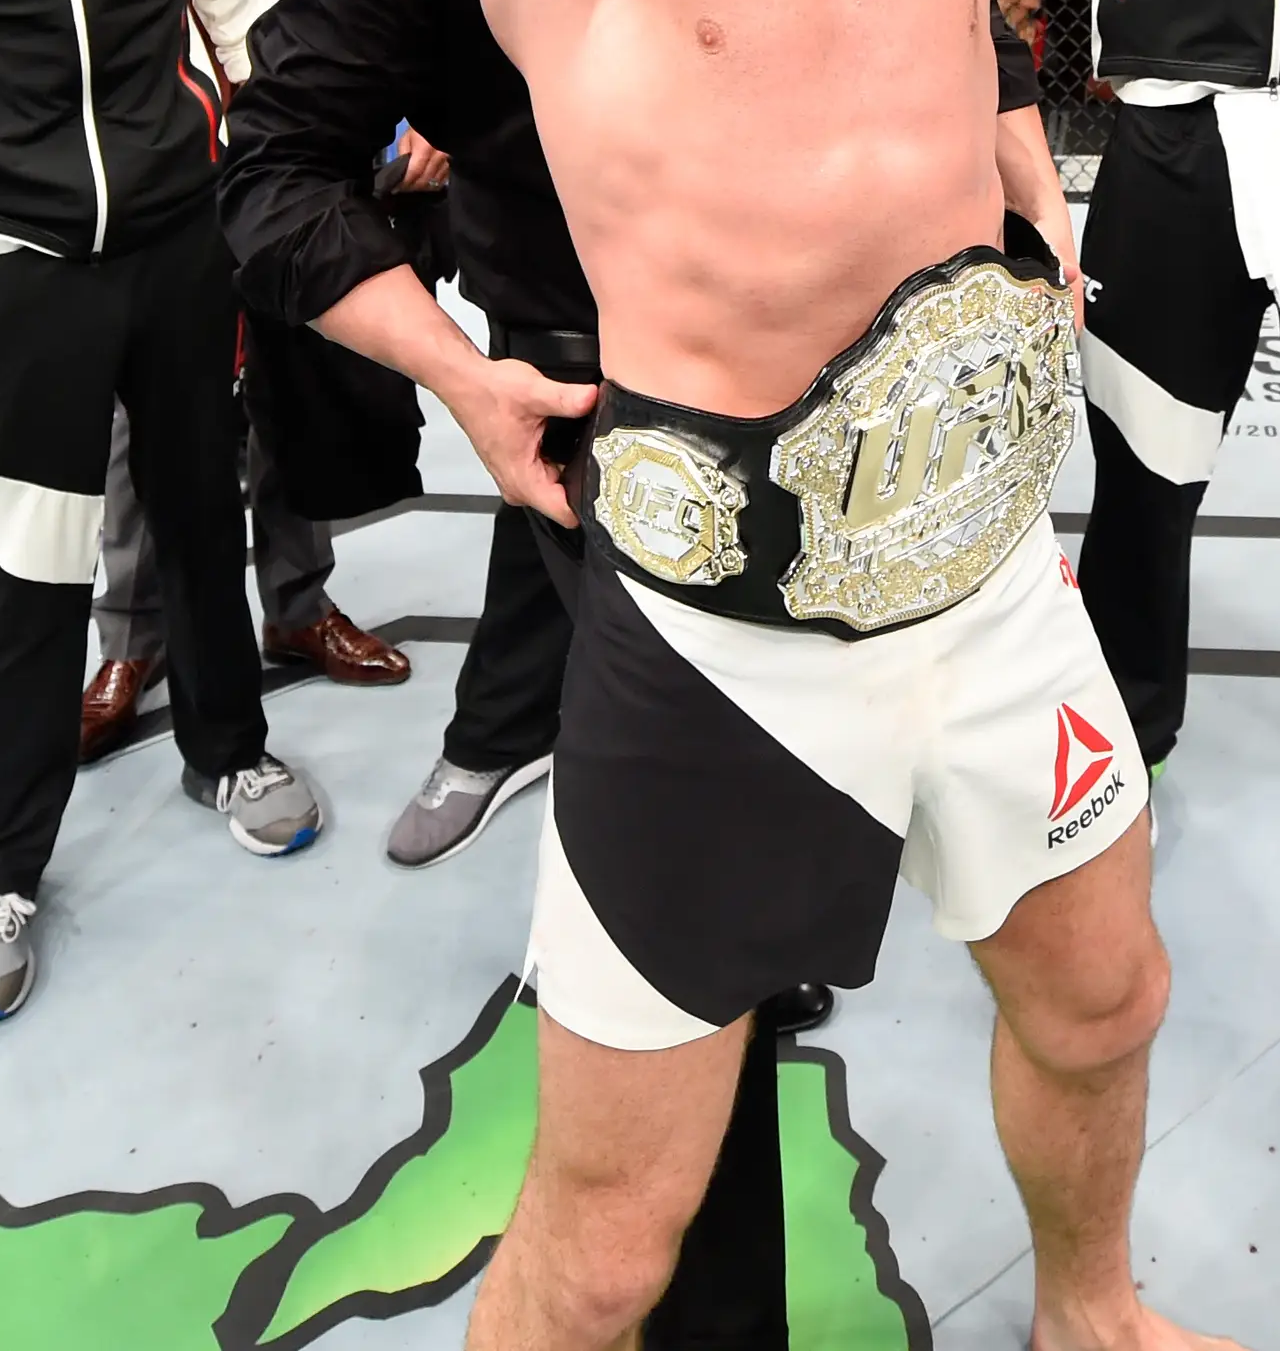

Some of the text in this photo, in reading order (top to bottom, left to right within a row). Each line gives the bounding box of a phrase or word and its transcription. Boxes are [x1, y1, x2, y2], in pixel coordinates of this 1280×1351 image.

[844, 325, 1063, 528] UFC
[616, 471, 702, 534] UFC
[1047, 769, 1126, 850] Reebok
